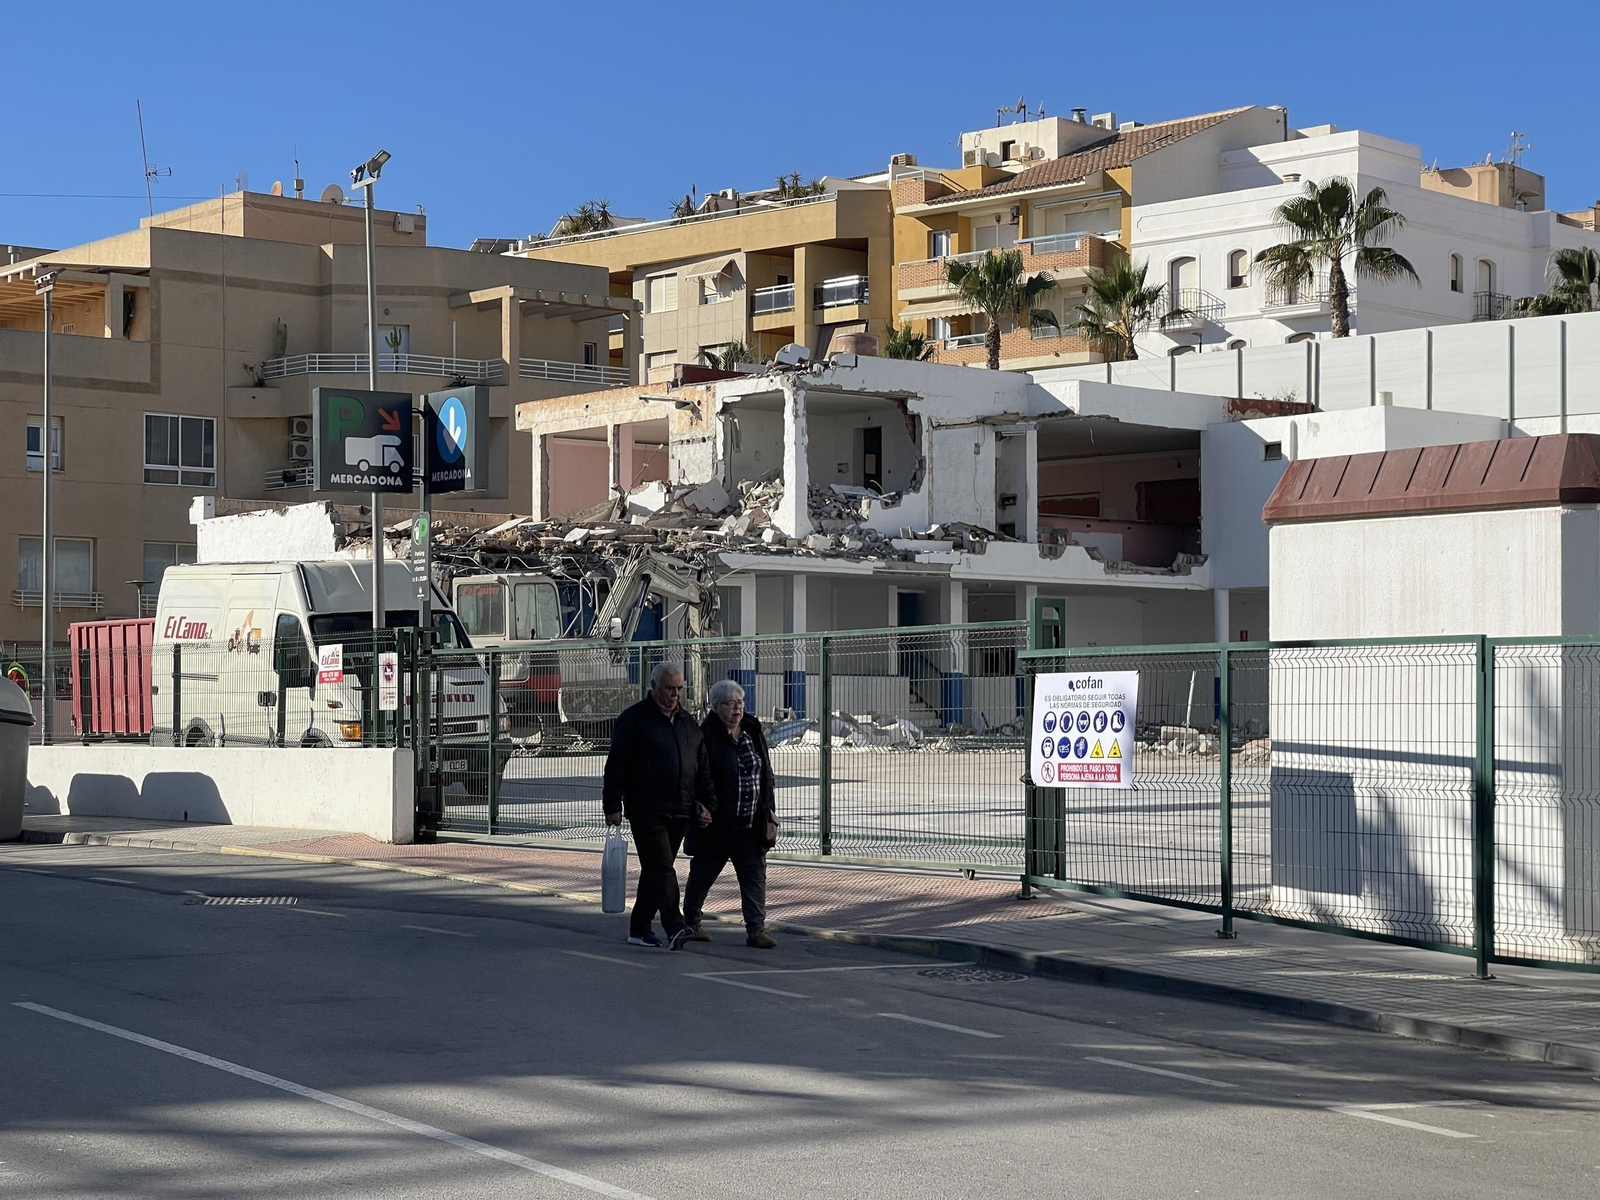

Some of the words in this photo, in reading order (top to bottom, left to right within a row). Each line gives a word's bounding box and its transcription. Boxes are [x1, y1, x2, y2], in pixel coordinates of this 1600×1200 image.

[328, 395, 365, 444] P
[330, 473, 403, 486] MERCADONA
[431, 468, 472, 482] MERCADONA
[1075, 676, 1103, 690] cofan
[1044, 694, 1052, 702] ES
[1052, 694, 1087, 702] OBLIGATORIO
[1087, 693, 1107, 701] SEGUIR
[1108, 693, 1126, 701] TODAS
[1091, 701, 1122, 709] SEGURIDAD
[1060, 764, 1083, 772] PROHIBIDO
[1083, 764, 1089, 772] EL
[1089, 764, 1102, 772] PASO
[1105, 764, 1118, 772] TODA
[1060, 772, 1080, 780] PERSONA
[1080, 772, 1095, 781] AJENA
[1098, 773, 1105, 781] LA
[1105, 773, 1119, 781] OBRA
